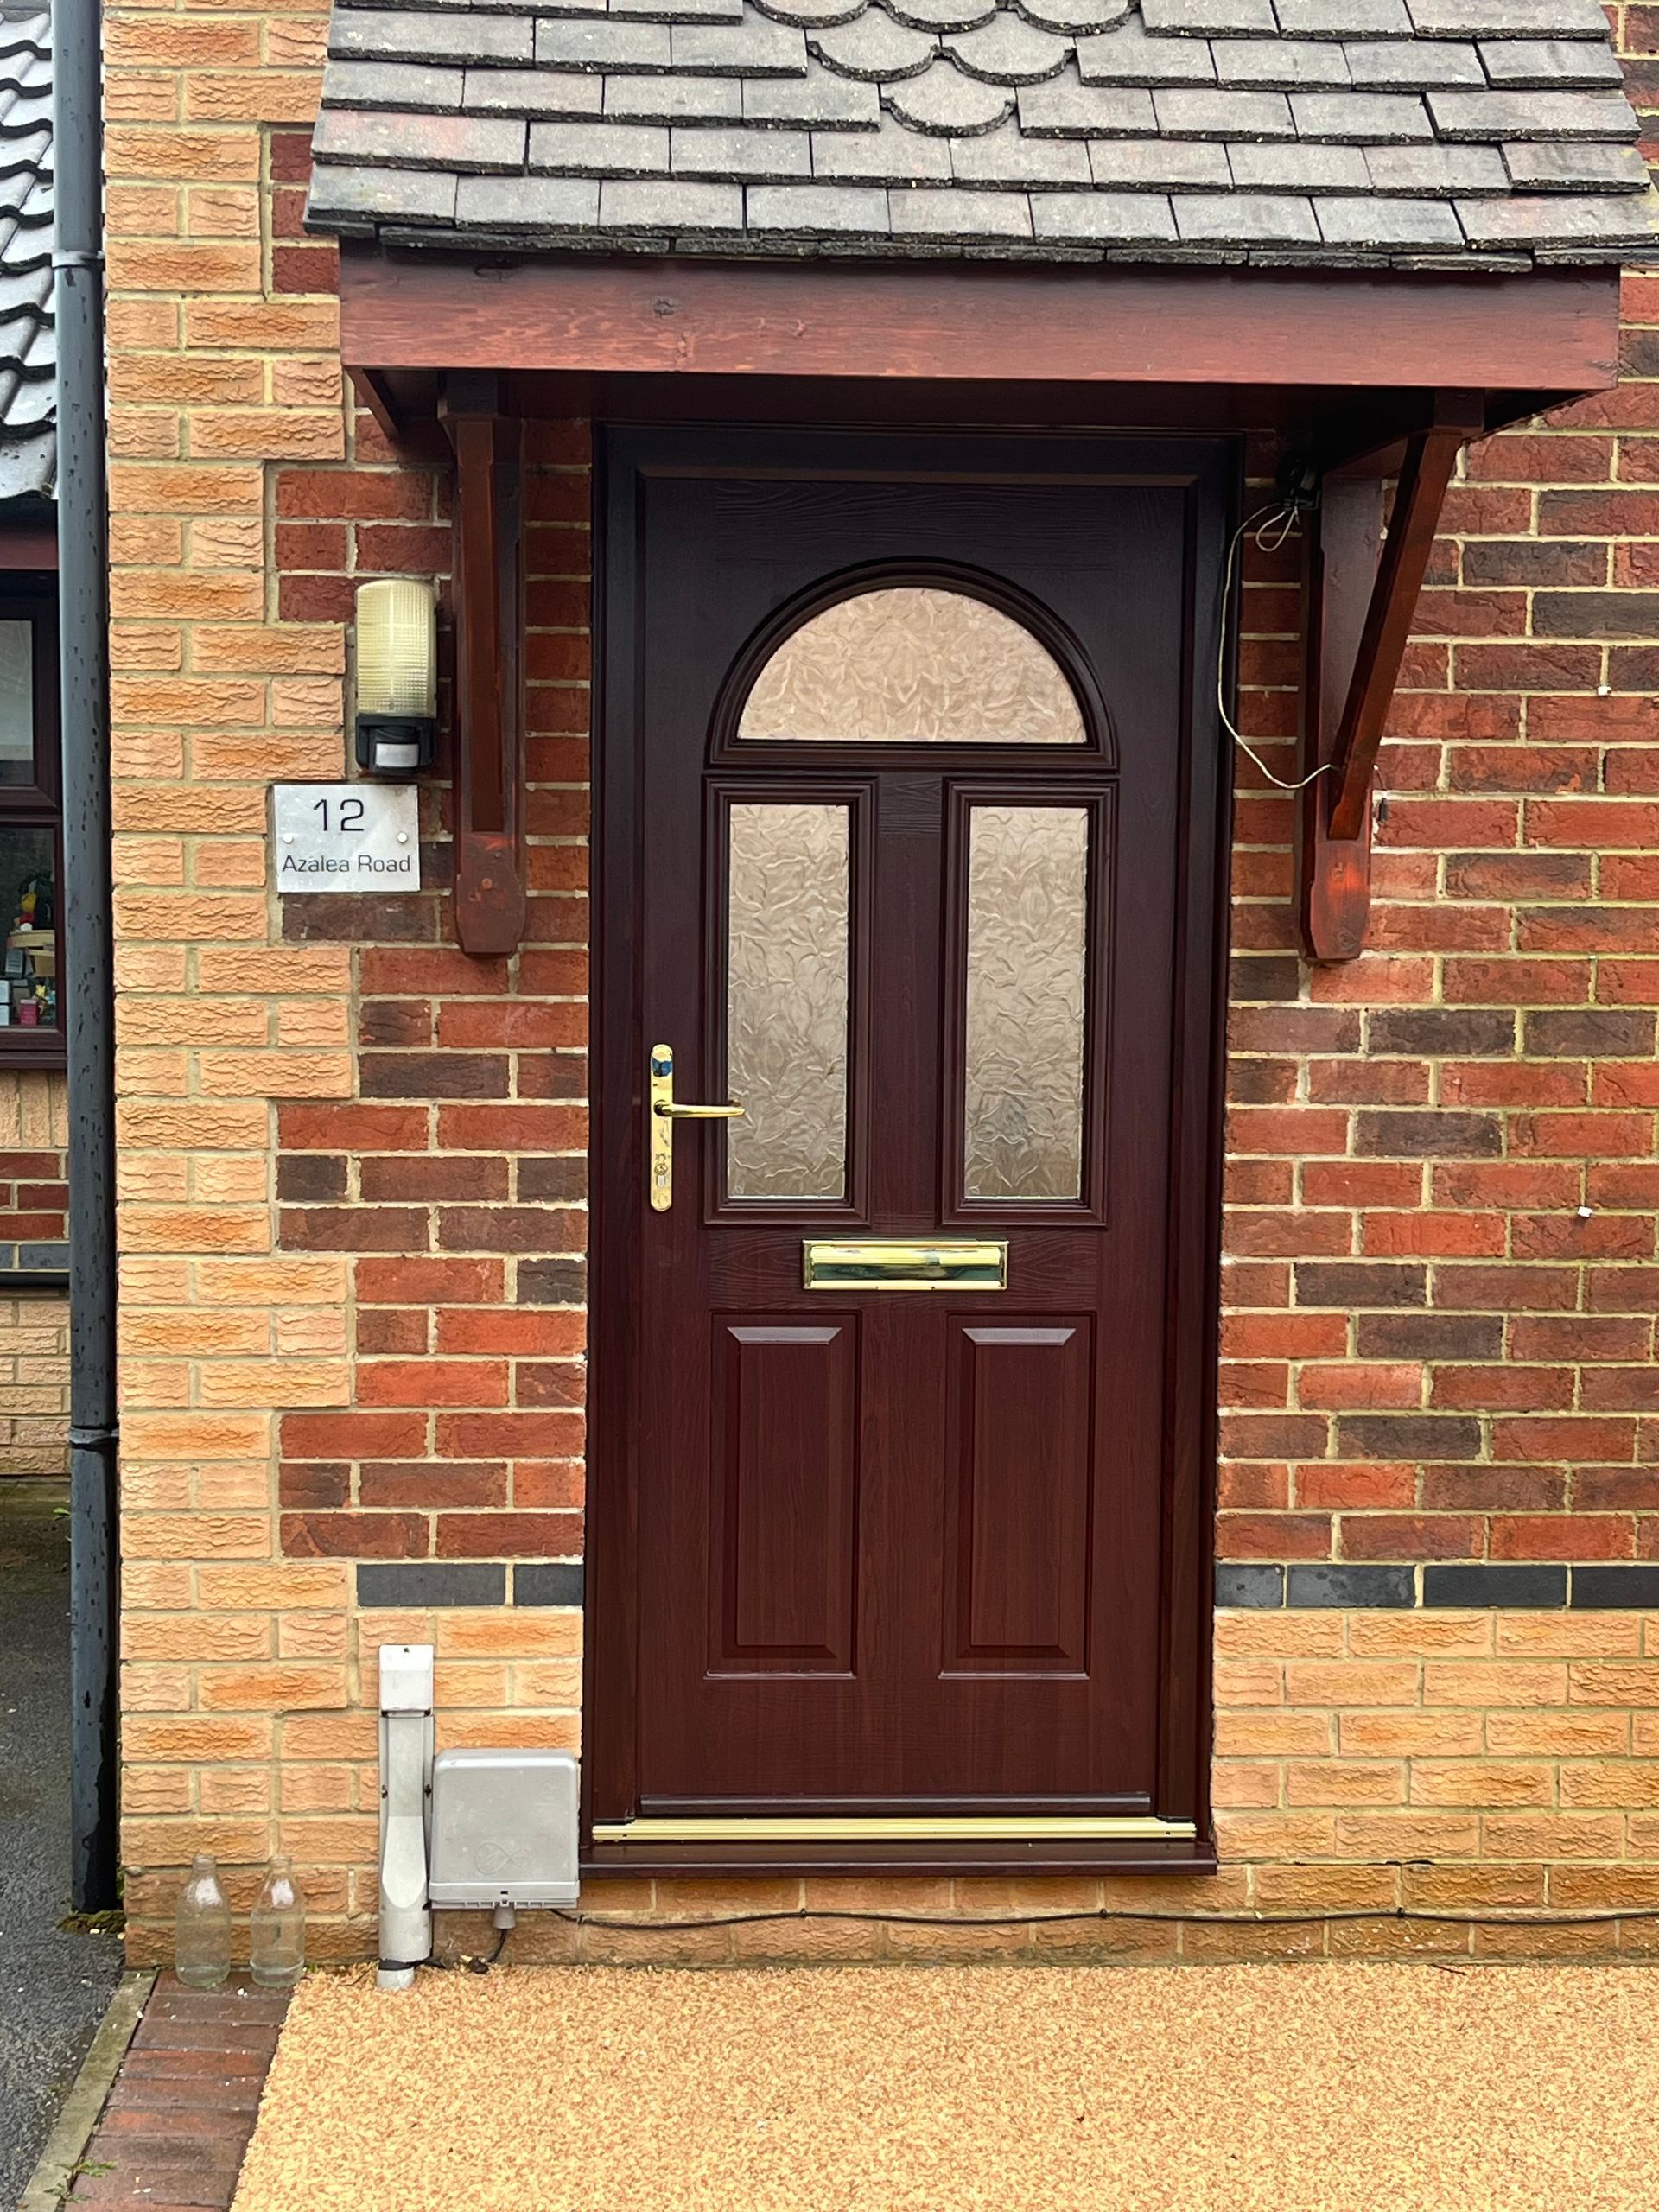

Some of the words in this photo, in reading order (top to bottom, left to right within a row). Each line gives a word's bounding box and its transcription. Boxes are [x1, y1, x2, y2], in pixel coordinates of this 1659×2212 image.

[313, 798, 365, 831] 12
[282, 855, 350, 873] Azalea
[357, 855, 410, 873] Road
